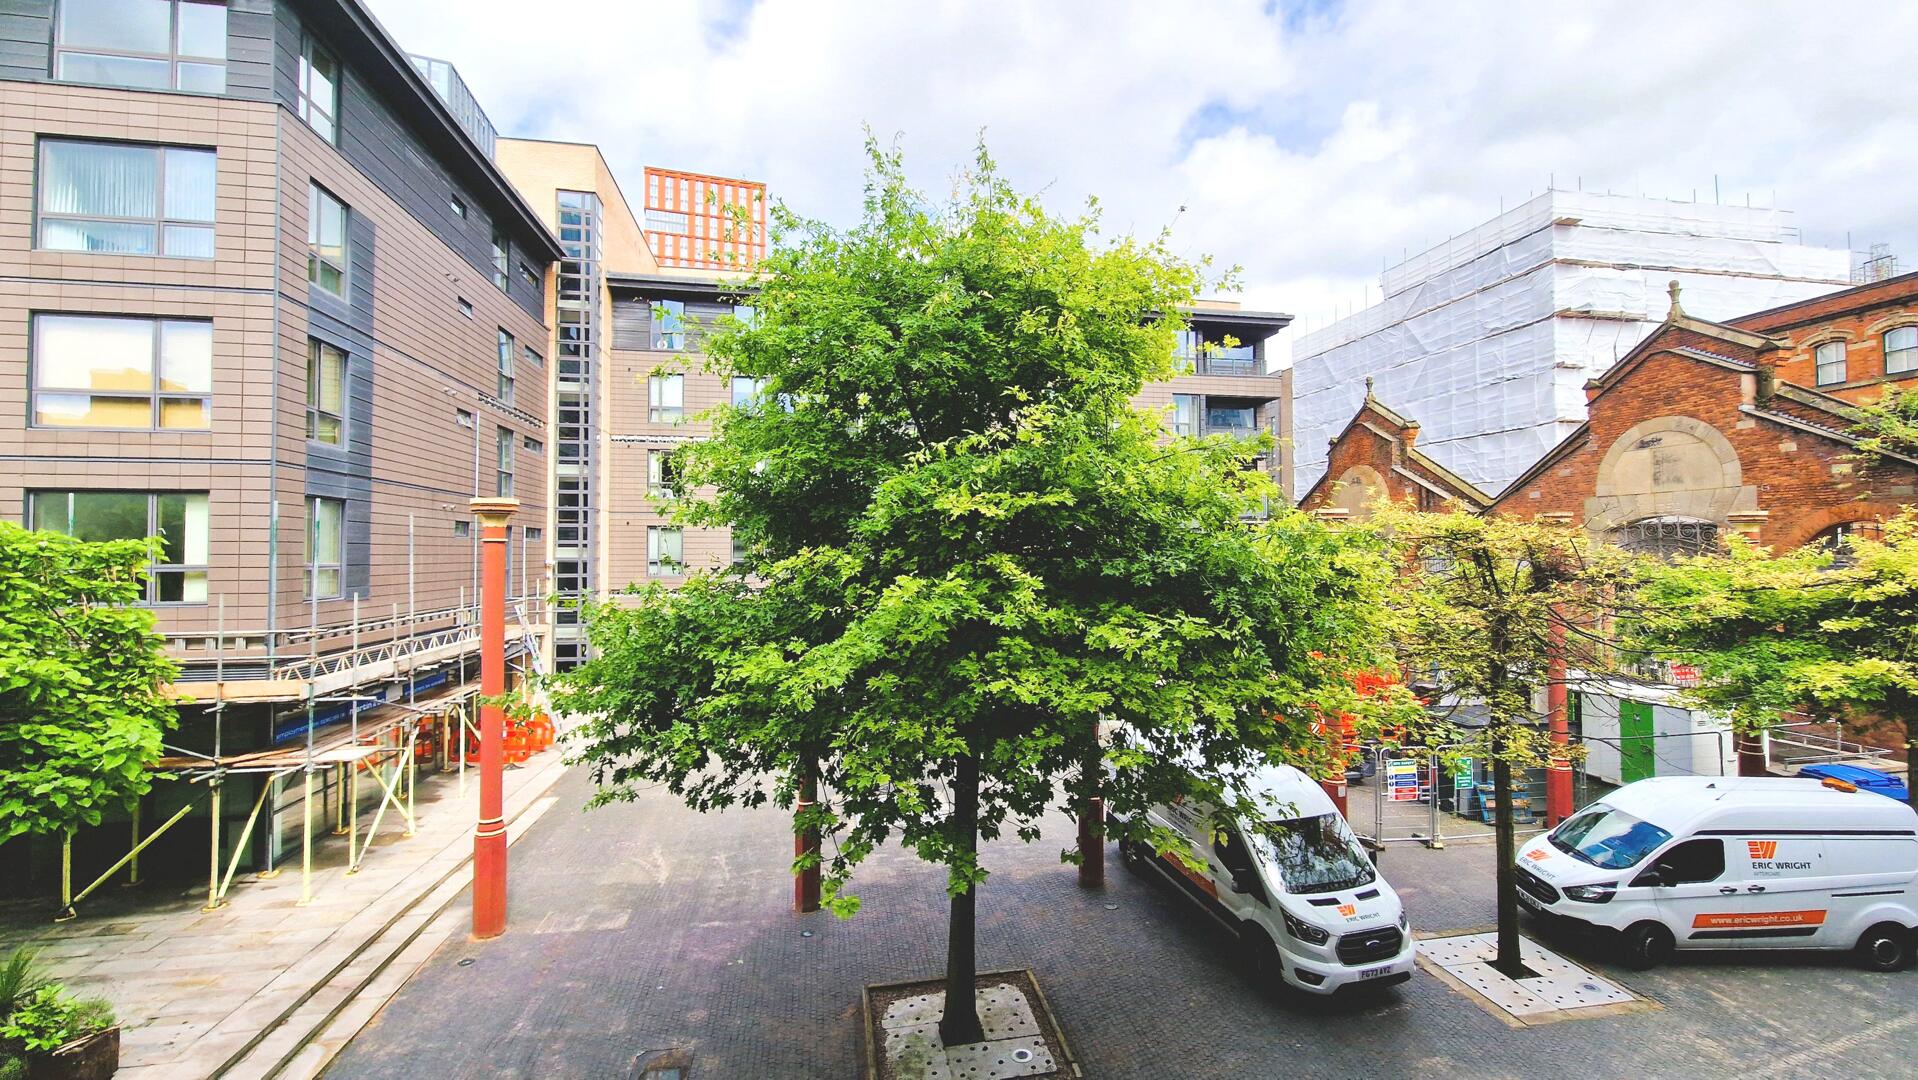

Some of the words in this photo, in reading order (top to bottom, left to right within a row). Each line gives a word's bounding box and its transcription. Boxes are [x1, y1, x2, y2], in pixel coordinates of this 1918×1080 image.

[1520, 857, 1531, 866] ERIC
[1531, 863, 1556, 880] WRIGHT
[1752, 861, 1774, 870] ERIC
[1775, 861, 1812, 870] WRIGHT
[1360, 912, 1380, 921] WRIGHT
[1710, 914, 1803, 925] www.ericwright.co.uk
